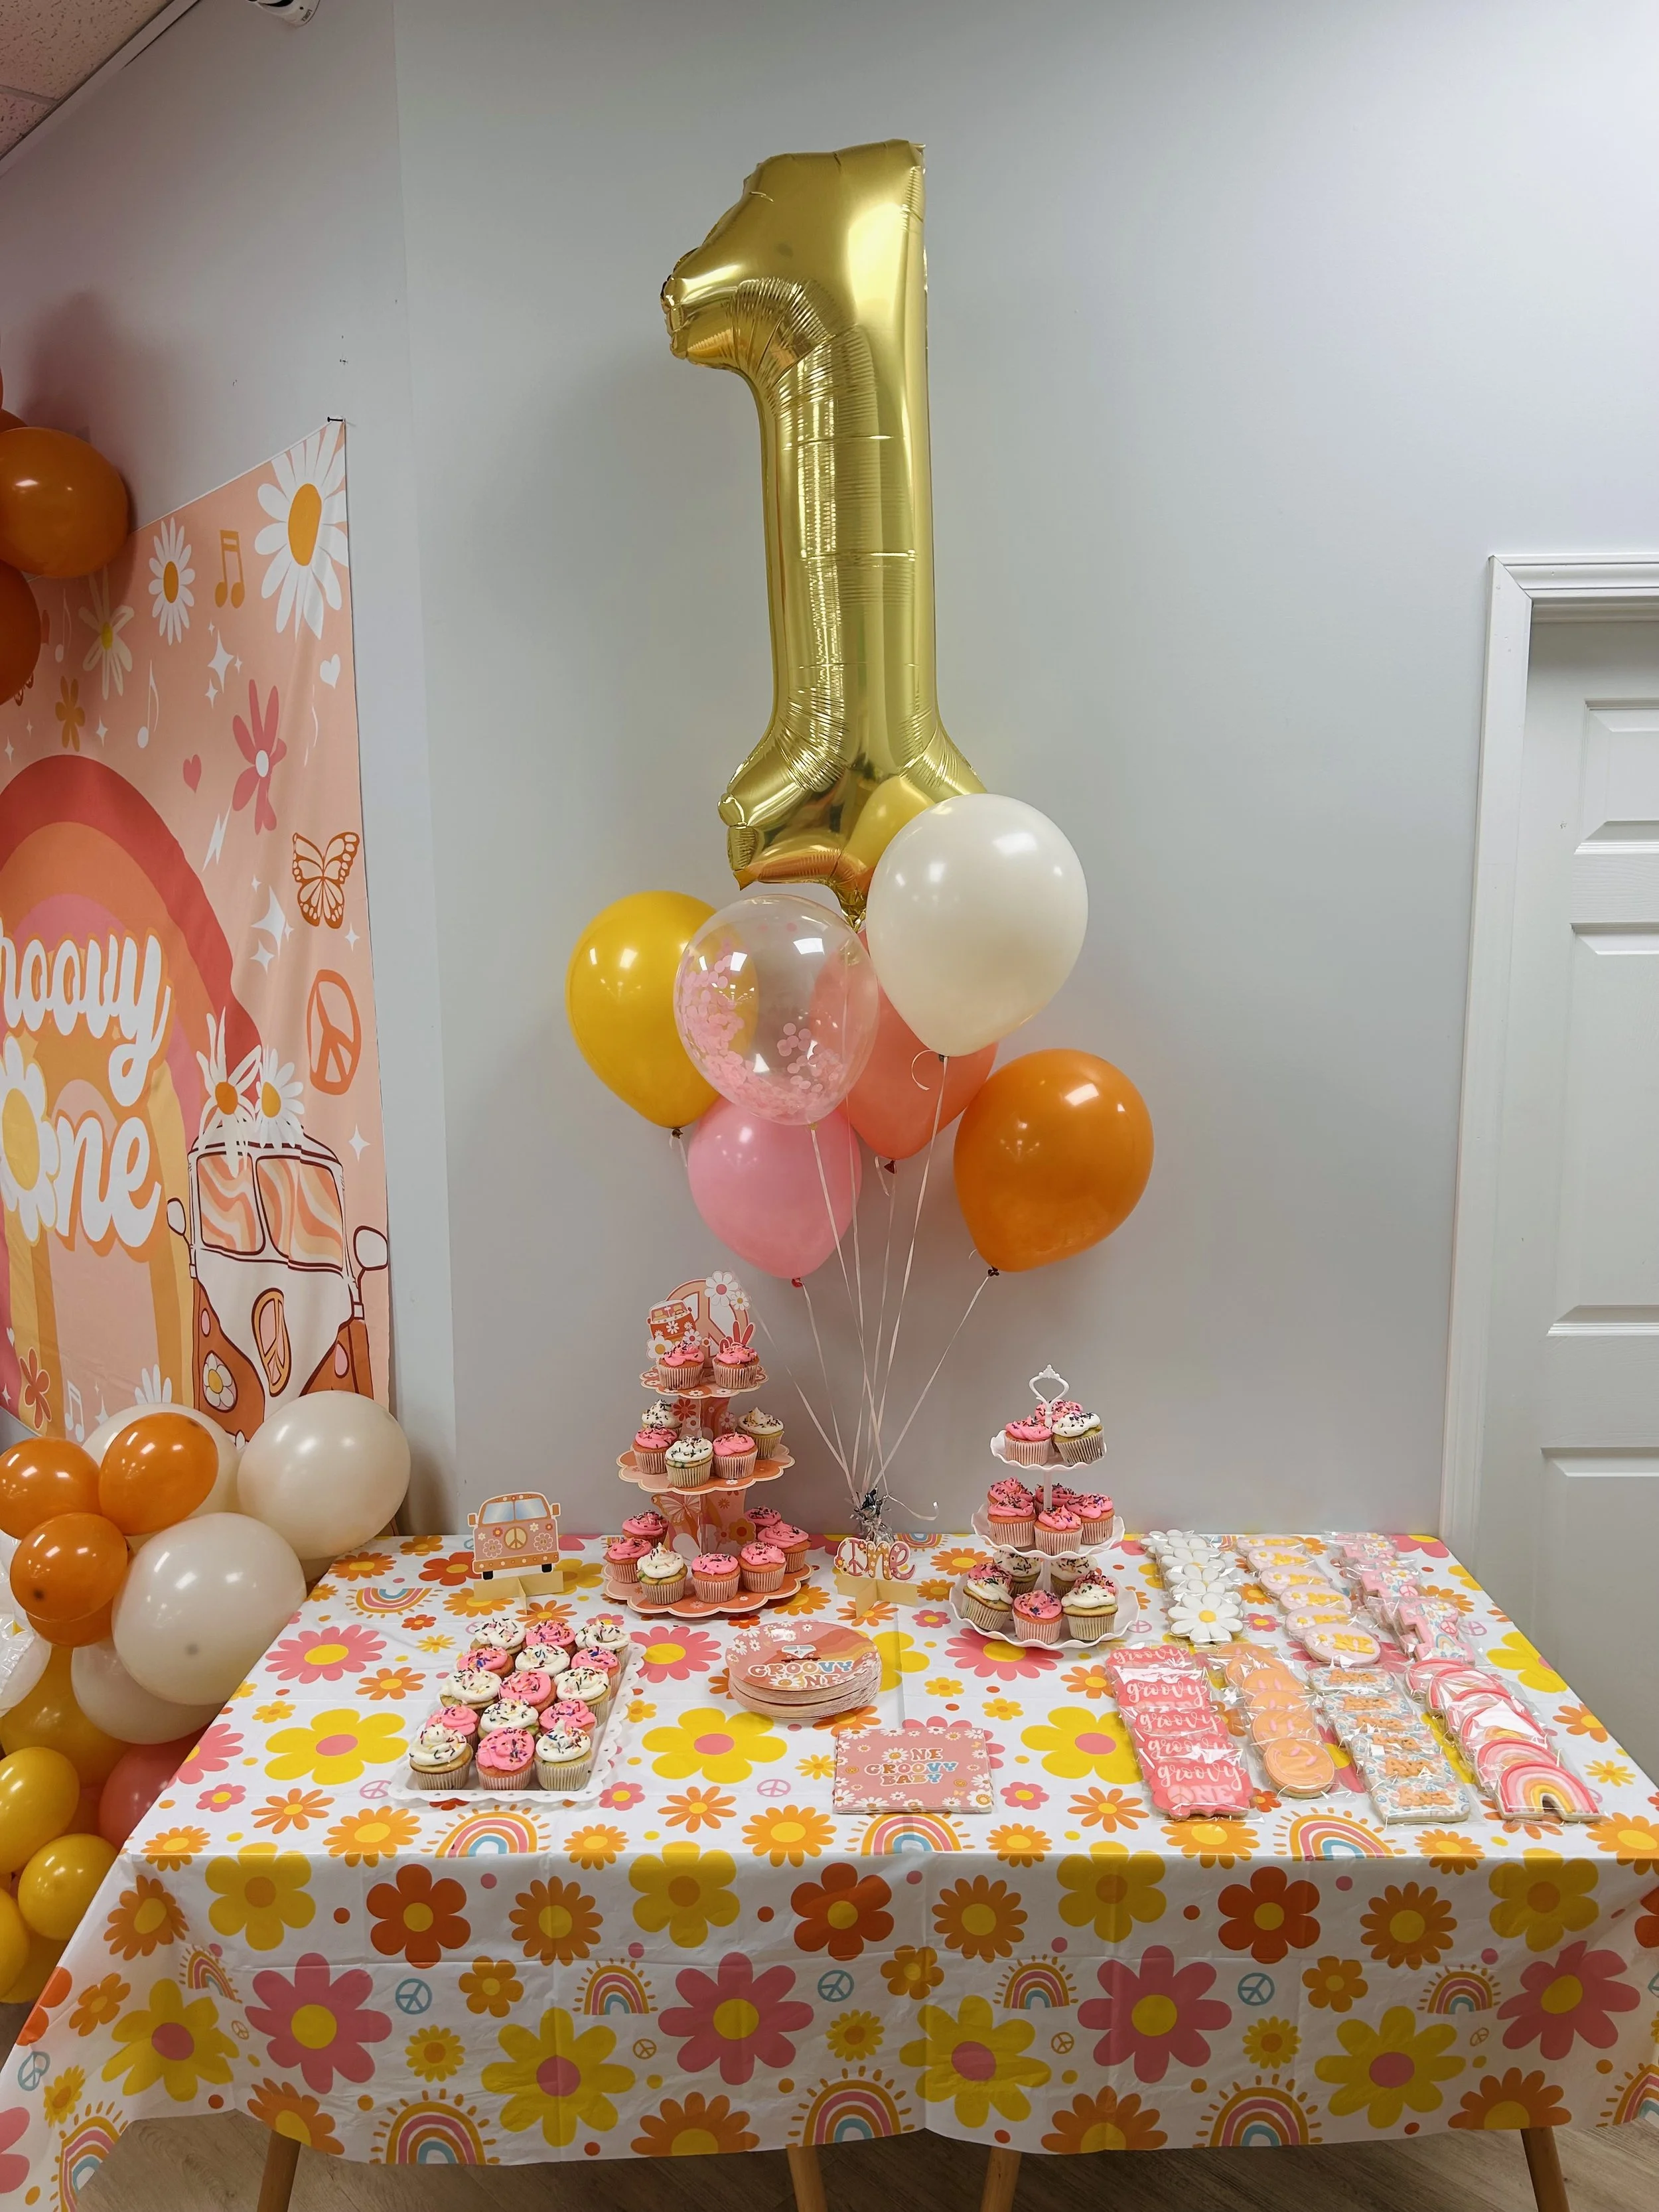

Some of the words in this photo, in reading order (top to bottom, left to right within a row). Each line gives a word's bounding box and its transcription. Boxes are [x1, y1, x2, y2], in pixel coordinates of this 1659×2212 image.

[1113, 1648, 1189, 1664] groovy
[748, 1660, 854, 1678] GROOVY
[1127, 1681, 1208, 1710] groovy
[1139, 1712, 1222, 1733] groovy
[864, 1761, 959, 1775] GROOVY
[880, 1773, 944, 1787] BABY
[1157, 1763, 1247, 1792] groovy
